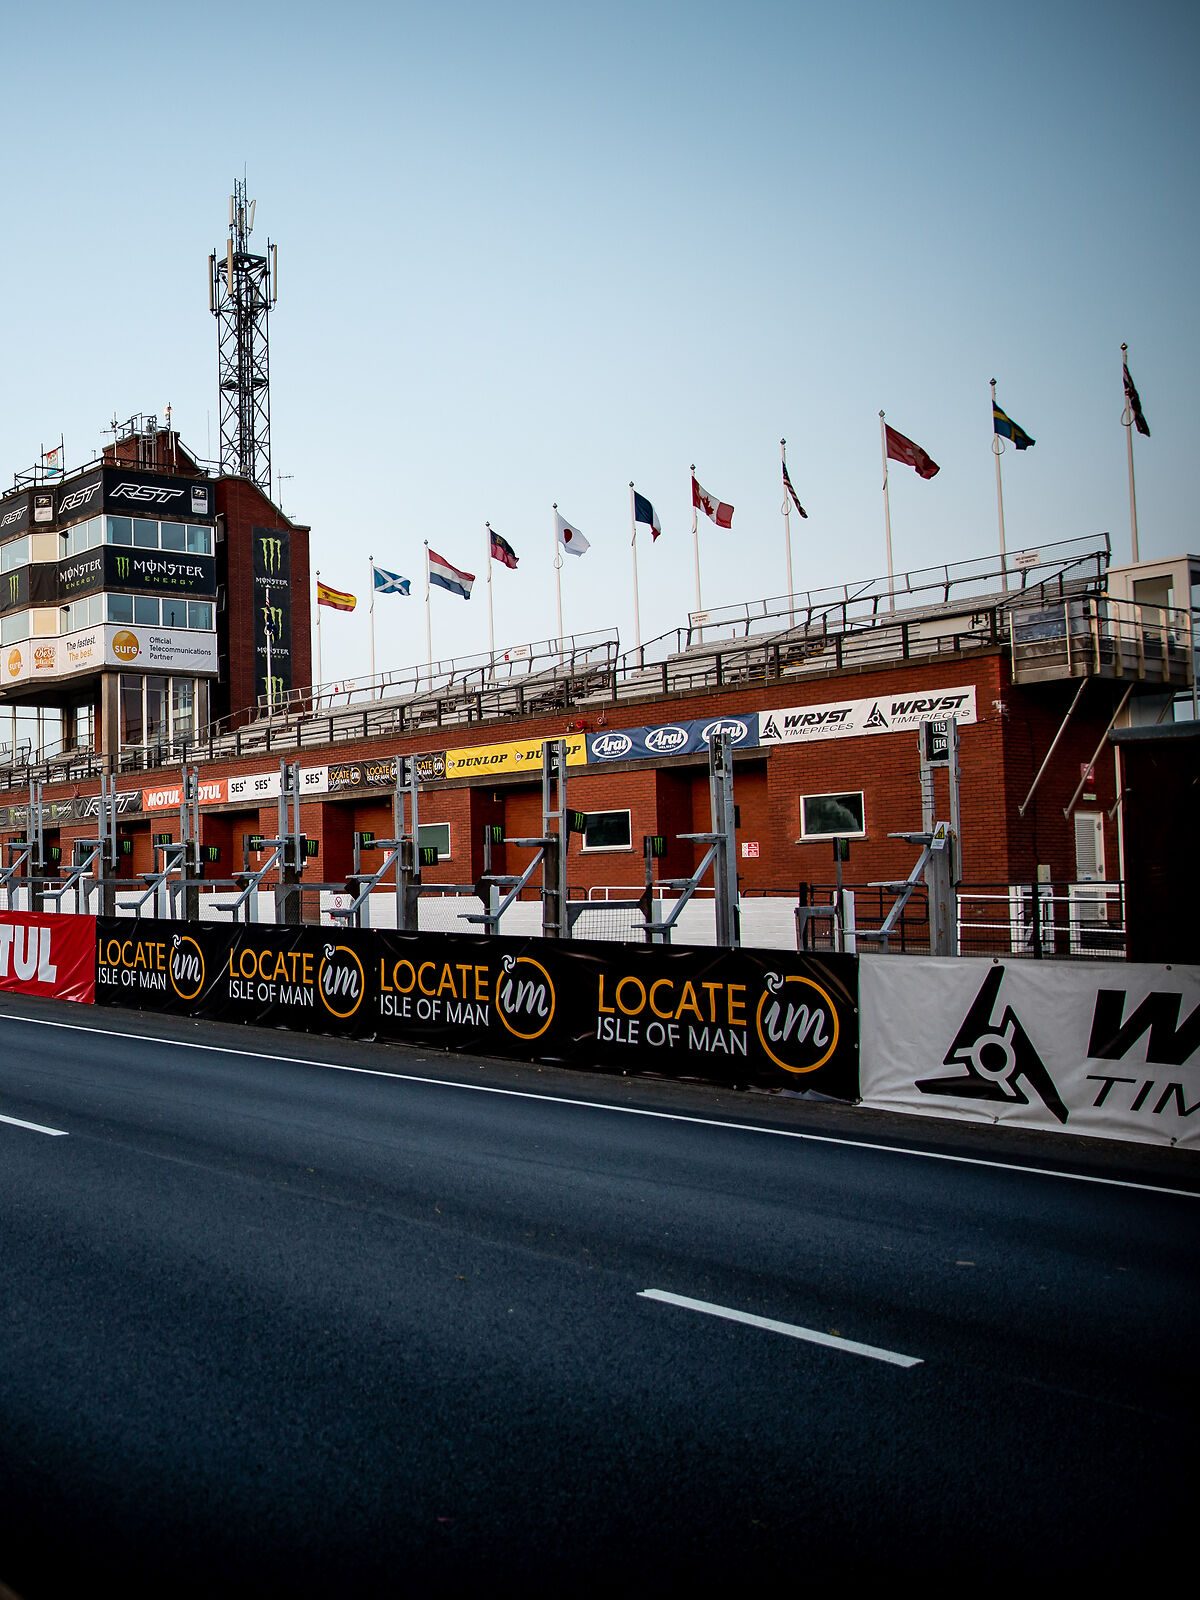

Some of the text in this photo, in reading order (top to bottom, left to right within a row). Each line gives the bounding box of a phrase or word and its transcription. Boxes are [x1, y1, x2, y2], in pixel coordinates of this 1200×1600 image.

[58, 482, 102, 514] RST
[109, 483, 185, 505] RST
[1, 505, 28, 528] RST
[59, 559, 102, 582] MONSTER
[133, 560, 205, 579] MONSTER
[65, 575, 96, 590] ENERGY
[144, 575, 195, 586] ENERGY
[255, 576, 289, 587] MONSTER
[67, 641, 76, 652] The
[149, 636, 172, 645] Official
[69, 652, 79, 662] The
[149, 644, 212, 657] Telecommunications
[149, 652, 174, 662] Partner
[890, 693, 970, 715] WRYST
[784, 708, 853, 728] WRYST
[890, 709, 971, 725] TIMEPIECES
[784, 722, 854, 736] TIMEPIECES
[934, 722, 947, 732] 115
[598, 737, 628, 752] Arai
[651, 730, 683, 746] Arai
[934, 739, 947, 749] 114
[525, 745, 581, 760] DUOP
[417, 760, 433, 771] CATE
[456, 754, 508, 768] DUNLOP
[366, 765, 390, 776] LOCATE
[254, 779, 268, 791] SES
[305, 773, 320, 785] SES
[196, 784, 222, 801] OTUL
[231, 782, 244, 793] SES
[84, 791, 141, 817] RT
[147, 789, 180, 807] MOTUL
[98, 938, 166, 972] LOCATE
[229, 947, 314, 984] LOCATE
[98, 967, 167, 991] ISLE OF MAN
[380, 958, 490, 1001] LOCATE
[229, 979, 314, 1007] ISLE OF MAN
[598, 973, 747, 1026] LOCATE
[380, 994, 490, 1027] ISLE OF MAN
[597, 1017, 747, 1057] ISLE OF MAN
